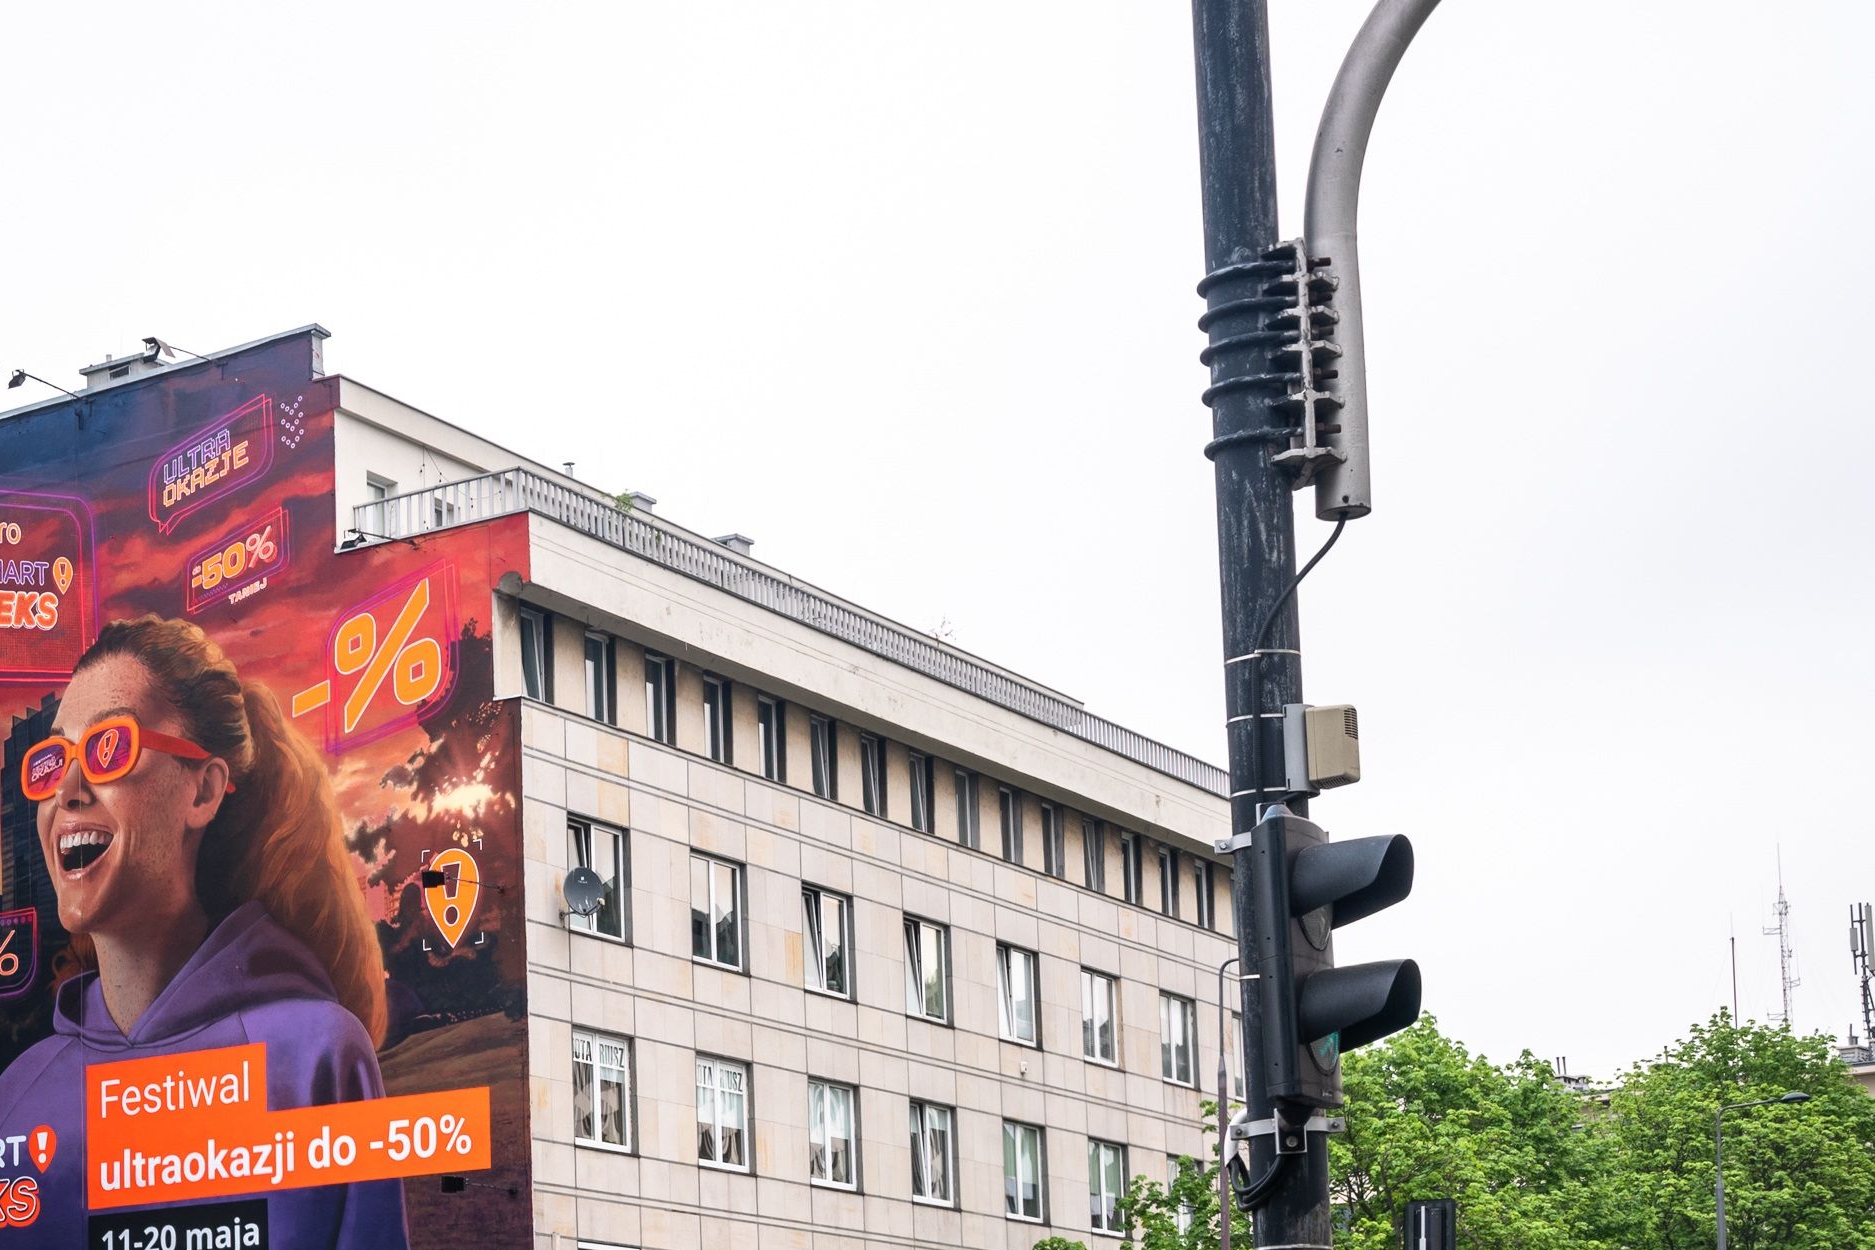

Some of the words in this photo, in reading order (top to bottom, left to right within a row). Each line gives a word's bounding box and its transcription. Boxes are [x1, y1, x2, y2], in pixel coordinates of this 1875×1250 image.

[163, 440, 249, 507] OKAZJE
[164, 428, 231, 485] ULTRA
[191, 525, 277, 590] -50%
[228, 577, 268, 605] TANIEJ
[100, 1061, 250, 1118] Festiwal
[100, 1131, 295, 1192] ultraokazji
[308, 1126, 356, 1169] do
[369, 1114, 472, 1162] -50%
